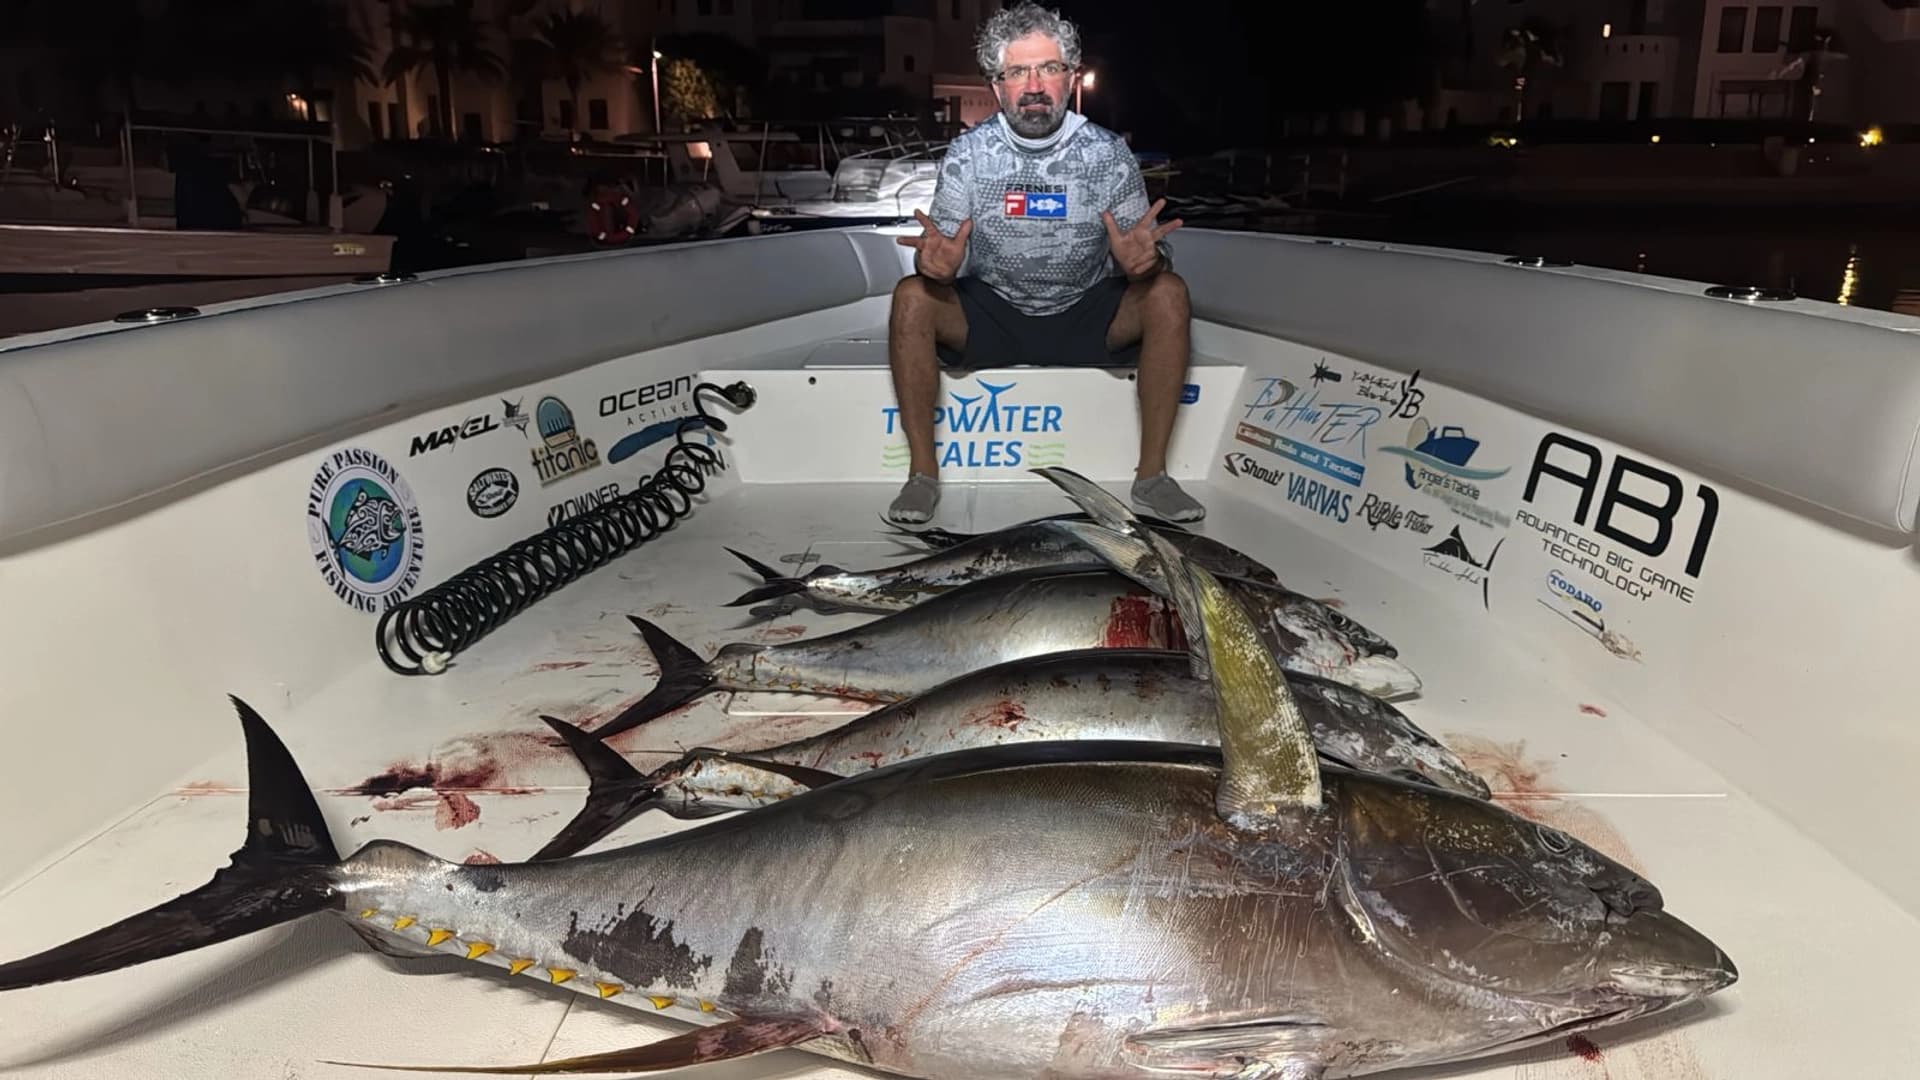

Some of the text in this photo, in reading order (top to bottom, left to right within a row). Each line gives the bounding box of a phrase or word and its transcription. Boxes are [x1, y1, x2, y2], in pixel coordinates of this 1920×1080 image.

[1006, 183, 1067, 193] FRENESI
[409, 414, 501, 457] MAXEL
[627, 401, 689, 427] ACTIVE
[882, 391, 1063, 435] TPWATER
[531, 435, 599, 482] titanic
[307, 448, 399, 519] PURE PASSION
[564, 483, 621, 520] OWNER
[1286, 471, 1354, 524] VARIVAS
[1522, 432, 1720, 579] AB1
[314, 506, 425, 614] FISHING ADVENTURE
[1515, 509, 1600, 557] ADVANCED
[1605, 550, 1635, 574] BIG
[1639, 567, 1696, 604] GAME
[1542, 538, 1653, 601] TECHNOLOGY
[1549, 573, 1603, 612] TODARO
